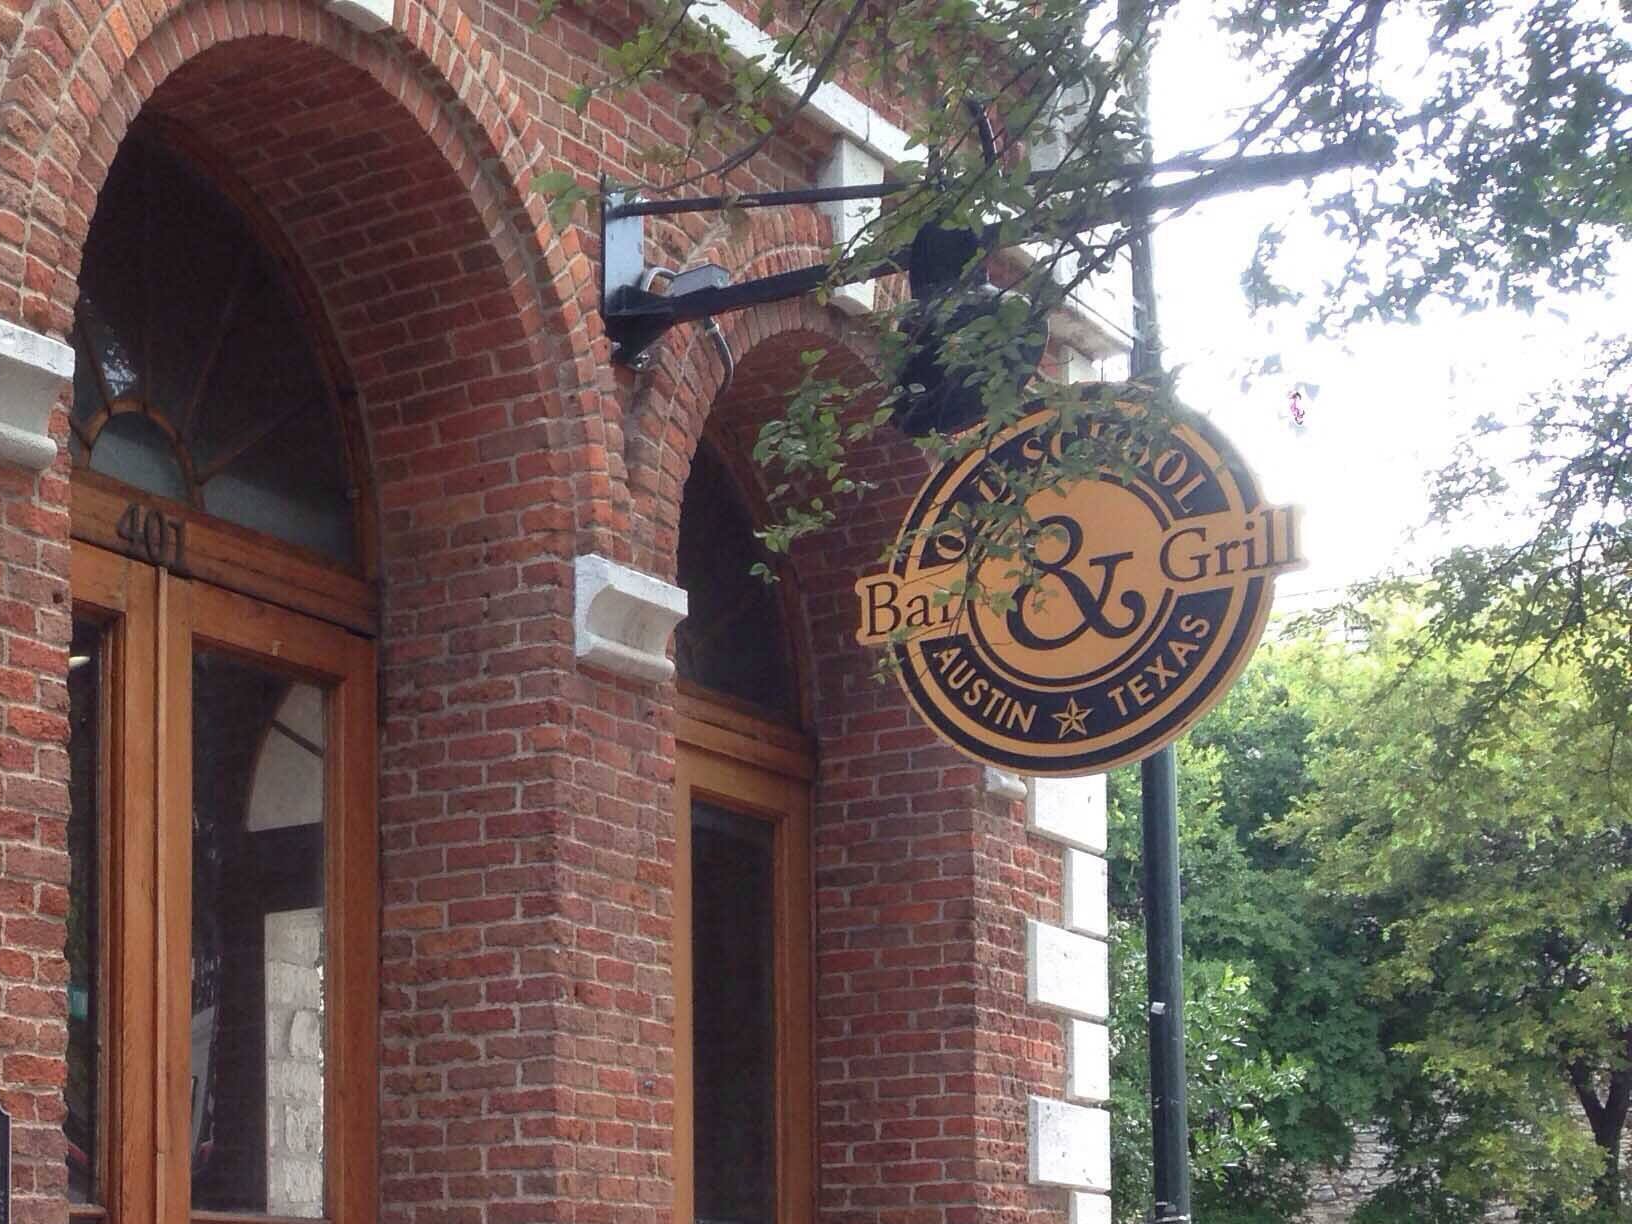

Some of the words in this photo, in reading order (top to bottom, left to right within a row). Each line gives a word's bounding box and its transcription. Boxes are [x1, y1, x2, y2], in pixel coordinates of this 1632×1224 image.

[936, 465, 1016, 560] OD
[1022, 420, 1207, 514] SCOL
[866, 579, 954, 636] Bar
[1007, 514, 1146, 651] &
[1159, 506, 1303, 583] Grill
[932, 646, 1037, 734] AUSTIN
[1107, 614, 1210, 717] TEXAS
